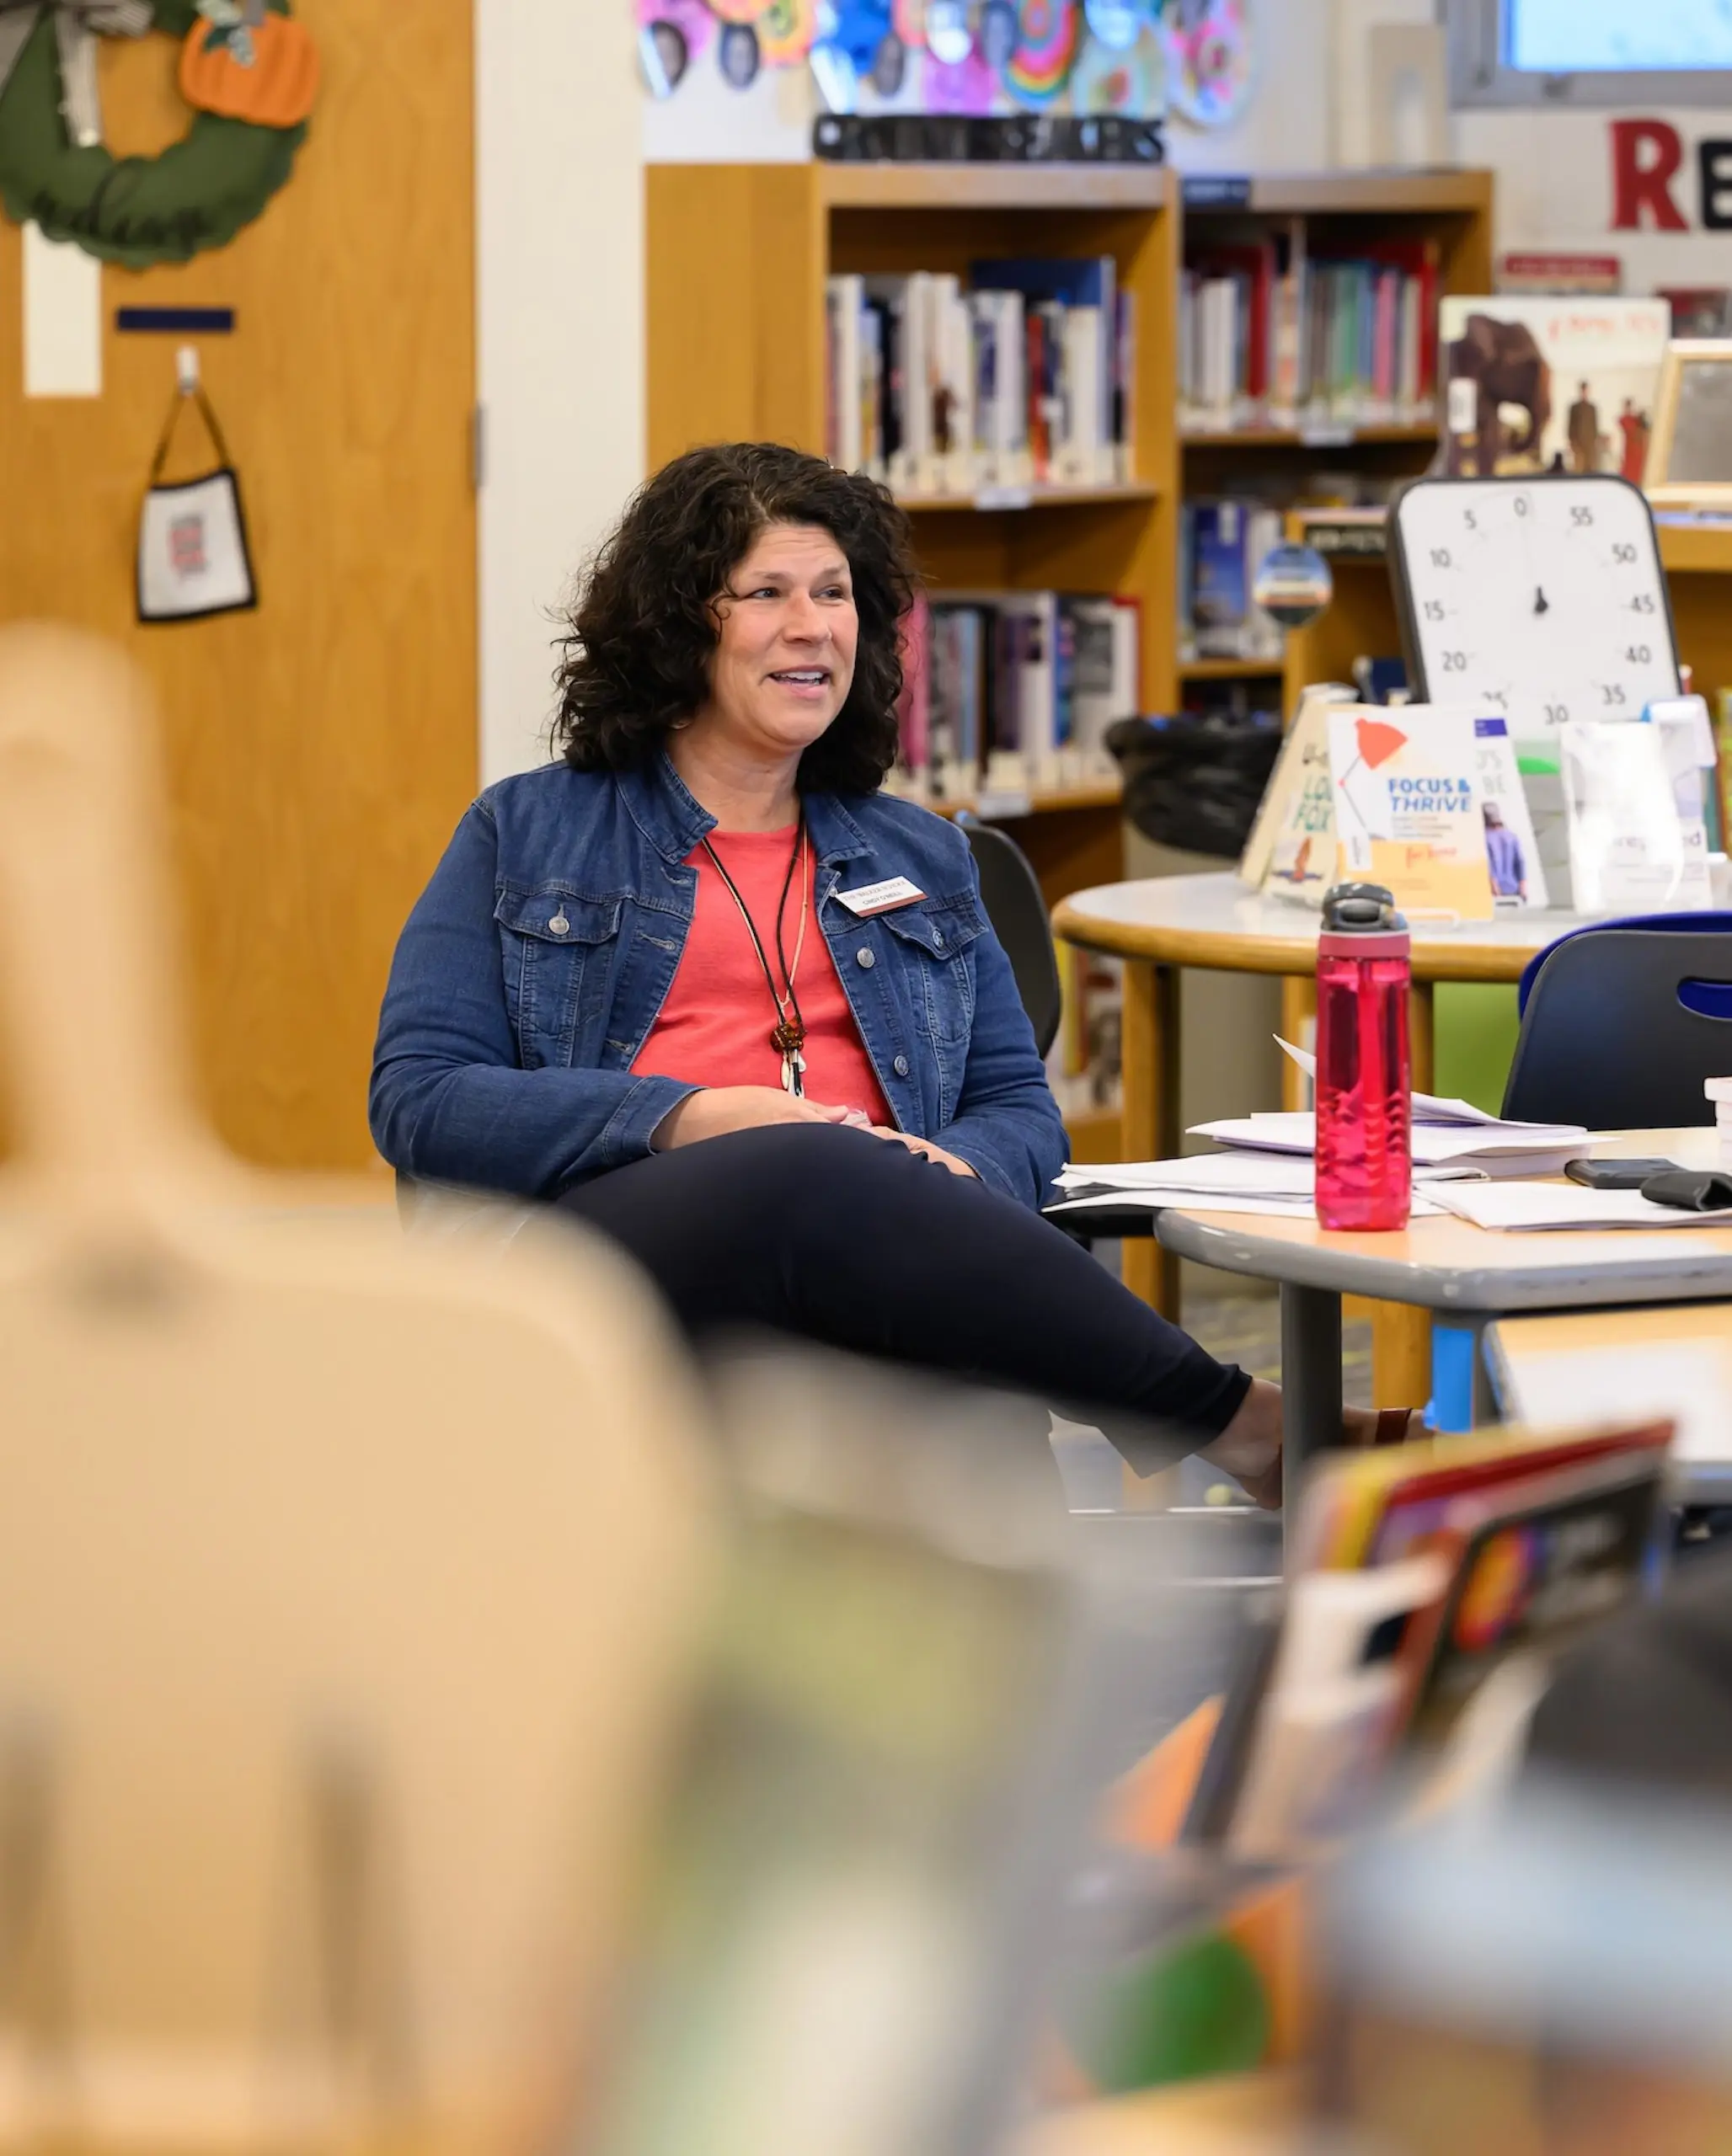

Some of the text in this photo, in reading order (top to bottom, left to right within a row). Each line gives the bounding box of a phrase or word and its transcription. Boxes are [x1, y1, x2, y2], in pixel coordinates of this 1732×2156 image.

[1514, 498, 1527, 517] 0
[1570, 507, 1592, 526] 55
[1464, 510, 1477, 529] 5
[1430, 549, 1451, 568] 10
[1612, 543, 1637, 563] 50
[1425, 600, 1445, 620] 15
[1631, 595, 1654, 614] 45
[1442, 651, 1467, 671] 20
[1626, 645, 1651, 664] 40
[1603, 685, 1626, 705] 35
[1543, 704, 1569, 724] 30
[1388, 778, 1453, 793] FOCUS
[1392, 797, 1471, 811] THRIVE
